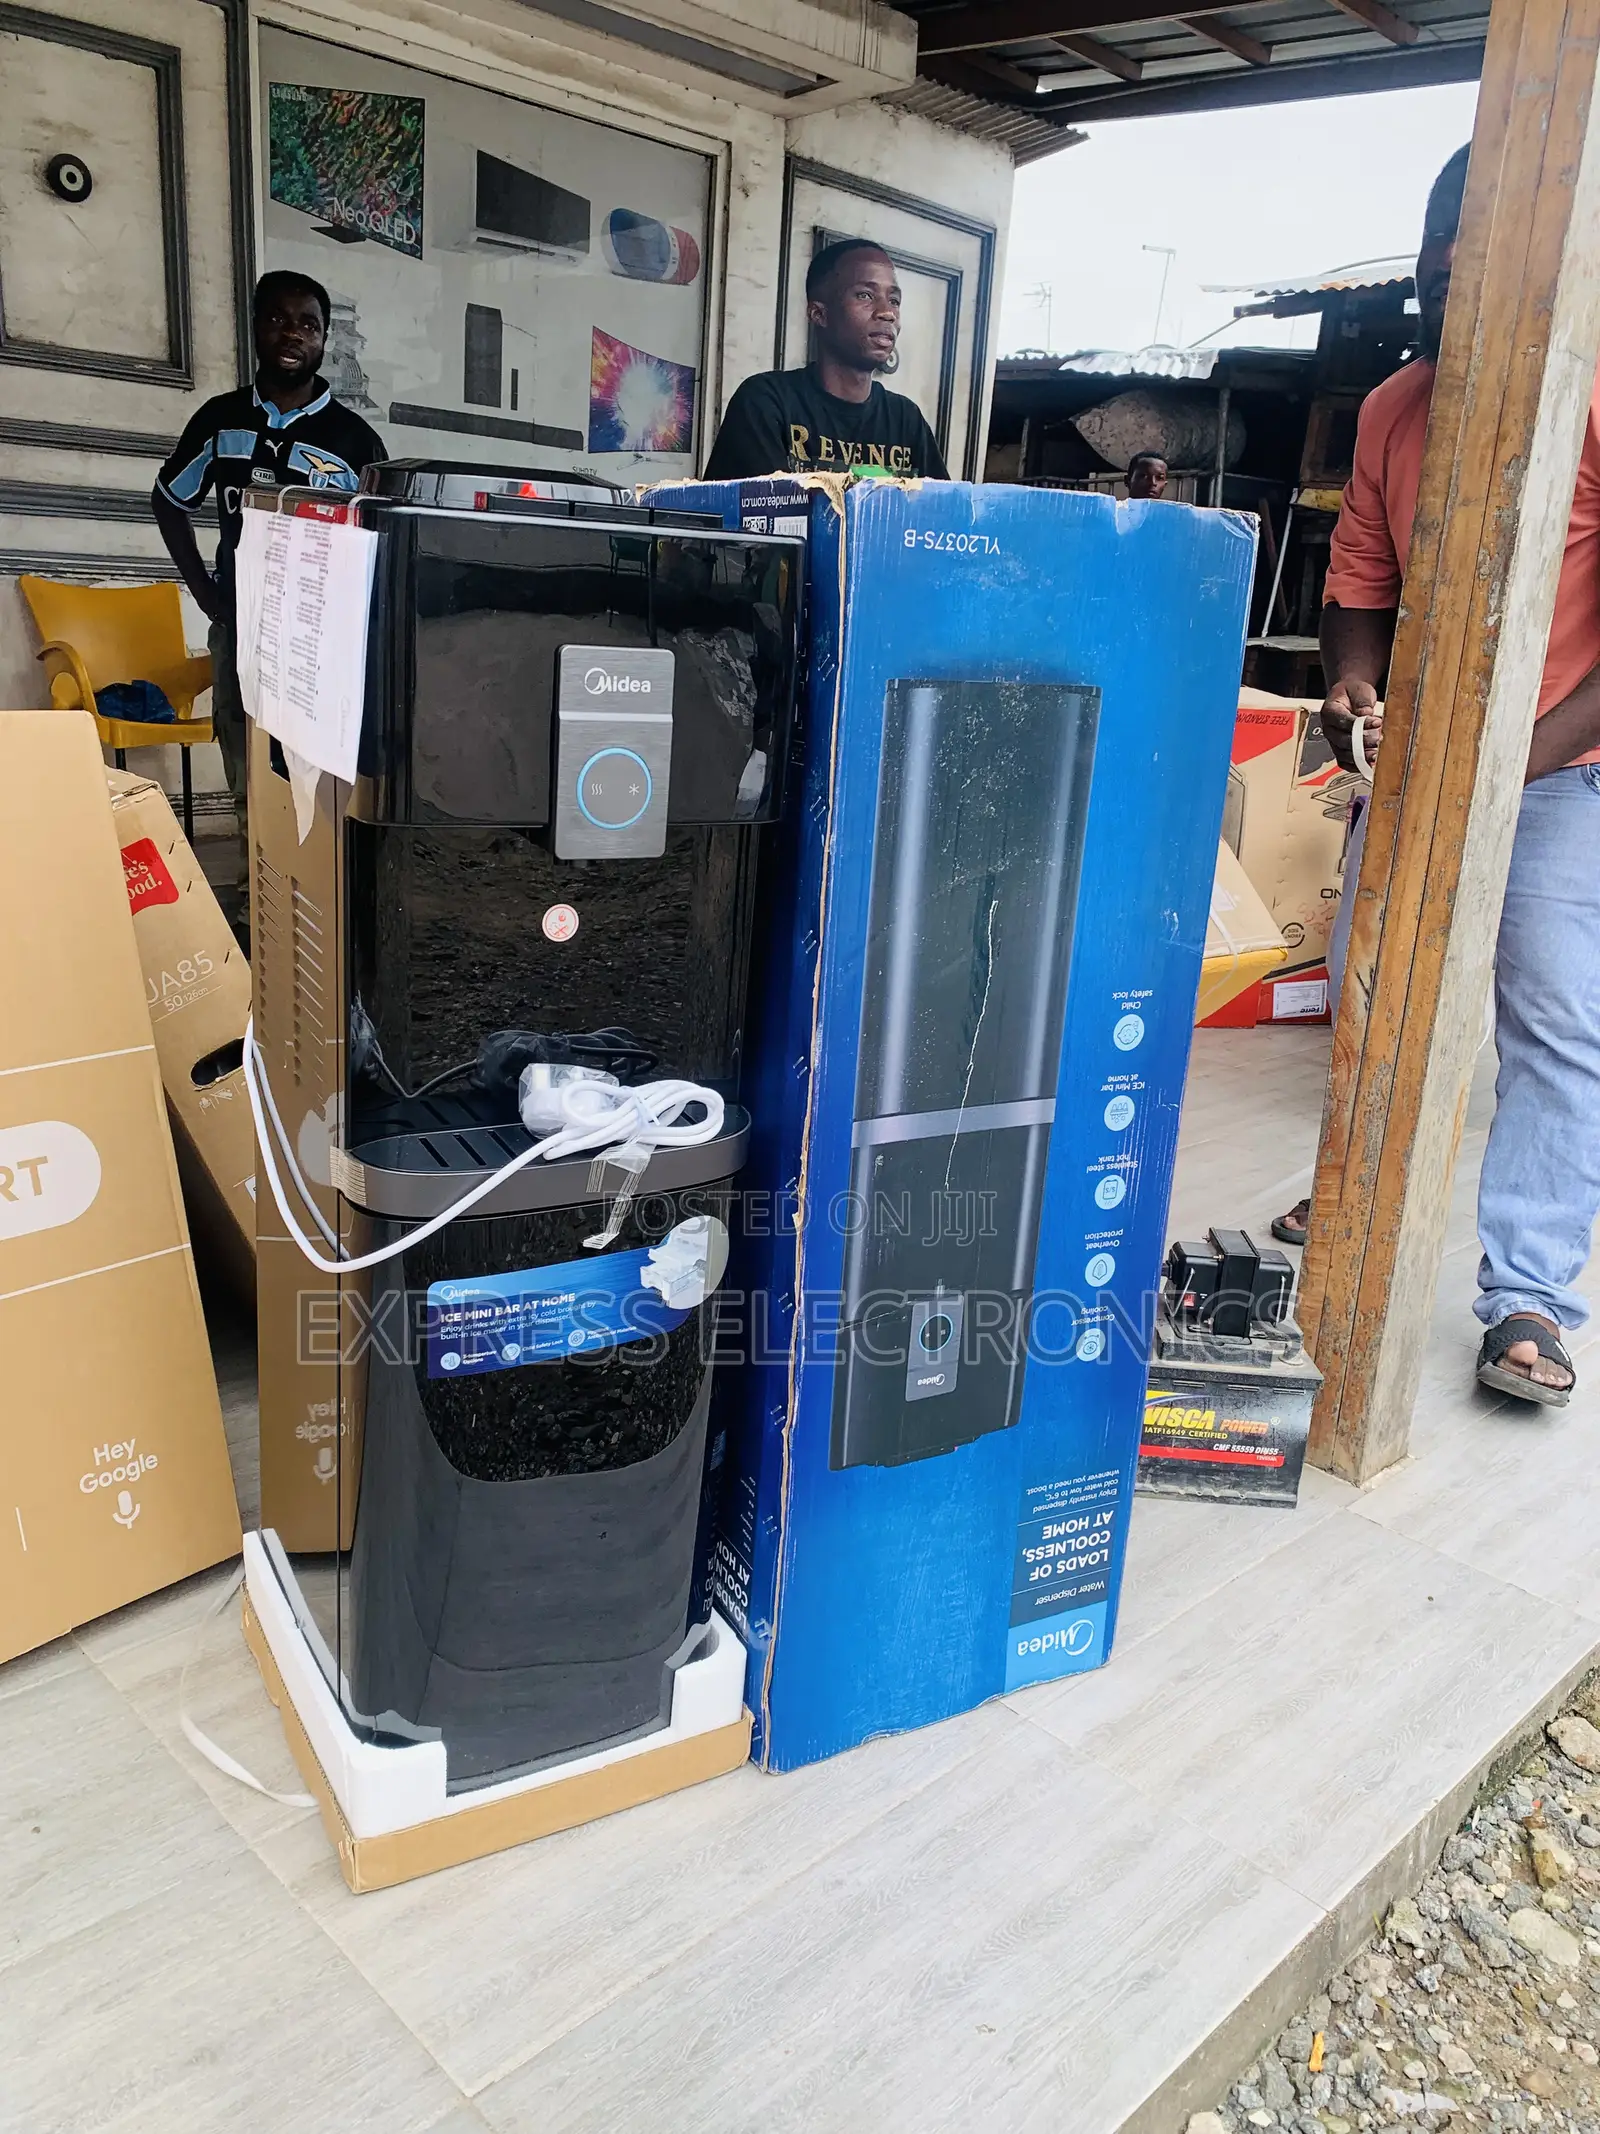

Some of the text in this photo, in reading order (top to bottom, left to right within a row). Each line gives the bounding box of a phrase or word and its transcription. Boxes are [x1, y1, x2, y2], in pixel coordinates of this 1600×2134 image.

[332, 197, 416, 244] Neo QLED
[790, 424, 912, 471] REVENGE
[742, 493, 809, 509] www.midea.com.cn
[904, 529, 1001, 555] YL2037S-B
[584, 667, 651, 695] Midea
[1236, 713, 1291, 725] FREE STANDIN
[1112, 989, 1153, 999] safety lock
[164, 995, 183, 1012] 50
[1122, 1001, 1141, 1010] Child
[1107, 1073, 1138, 1083] at home
[1101, 1081, 1145, 1092] ICE Mini bar
[1098, 1153, 1130, 1164] hot tank
[1086, 1160, 1138, 1174] Stainless steel
[1085, 1229, 1124, 1241] protection
[1085, 1239, 1120, 1250] Overheat
[440, 1285, 480, 1300] Midea
[441, 1292, 576, 1323] ICE MINI BAR AT HOME
[1081, 1305, 1109, 1316] cooling
[440, 1300, 597, 1335] Enjoy drinks with extra icy cold brought by
[1071, 1314, 1115, 1327] Compressor
[440, 1313, 572, 1341] built-in ice maker in your dispenser.
[917, 1373, 945, 1387] Midea
[1143, 1406, 1268, 1434] VISCA POWER
[1144, 1426, 1228, 1440] IATF16949 CERTIFIED
[93, 1438, 136, 1466] Hey
[1213, 1443, 1279, 1456] CMF 55559 DIN55
[79, 1453, 158, 1493] Google
[1086, 1469, 1120, 1482] whenever
[1054, 1479, 1072, 1489] need
[1073, 1476, 1086, 1486] you
[1083, 1482, 1102, 1492] water
[1104, 1478, 1119, 1489] cold
[1026, 1485, 1047, 1496] boost.
[1060, 1489, 1068, 1497] to
[1070, 1486, 1082, 1495] low
[1033, 1488, 1117, 1514] Enjoy instantly dispensed
[1042, 1510, 1114, 1540] AT HOME
[1022, 1530, 1111, 1564] COOLNESS,
[1029, 1548, 1109, 1582] LOADS OF
[738, 1565, 750, 1586] AT
[715, 1564, 749, 1607] COOLN
[1035, 1580, 1105, 1606] Water Dispenser
[716, 1583, 747, 1630] LOADS
[1017, 1619, 1095, 1656] Midea
